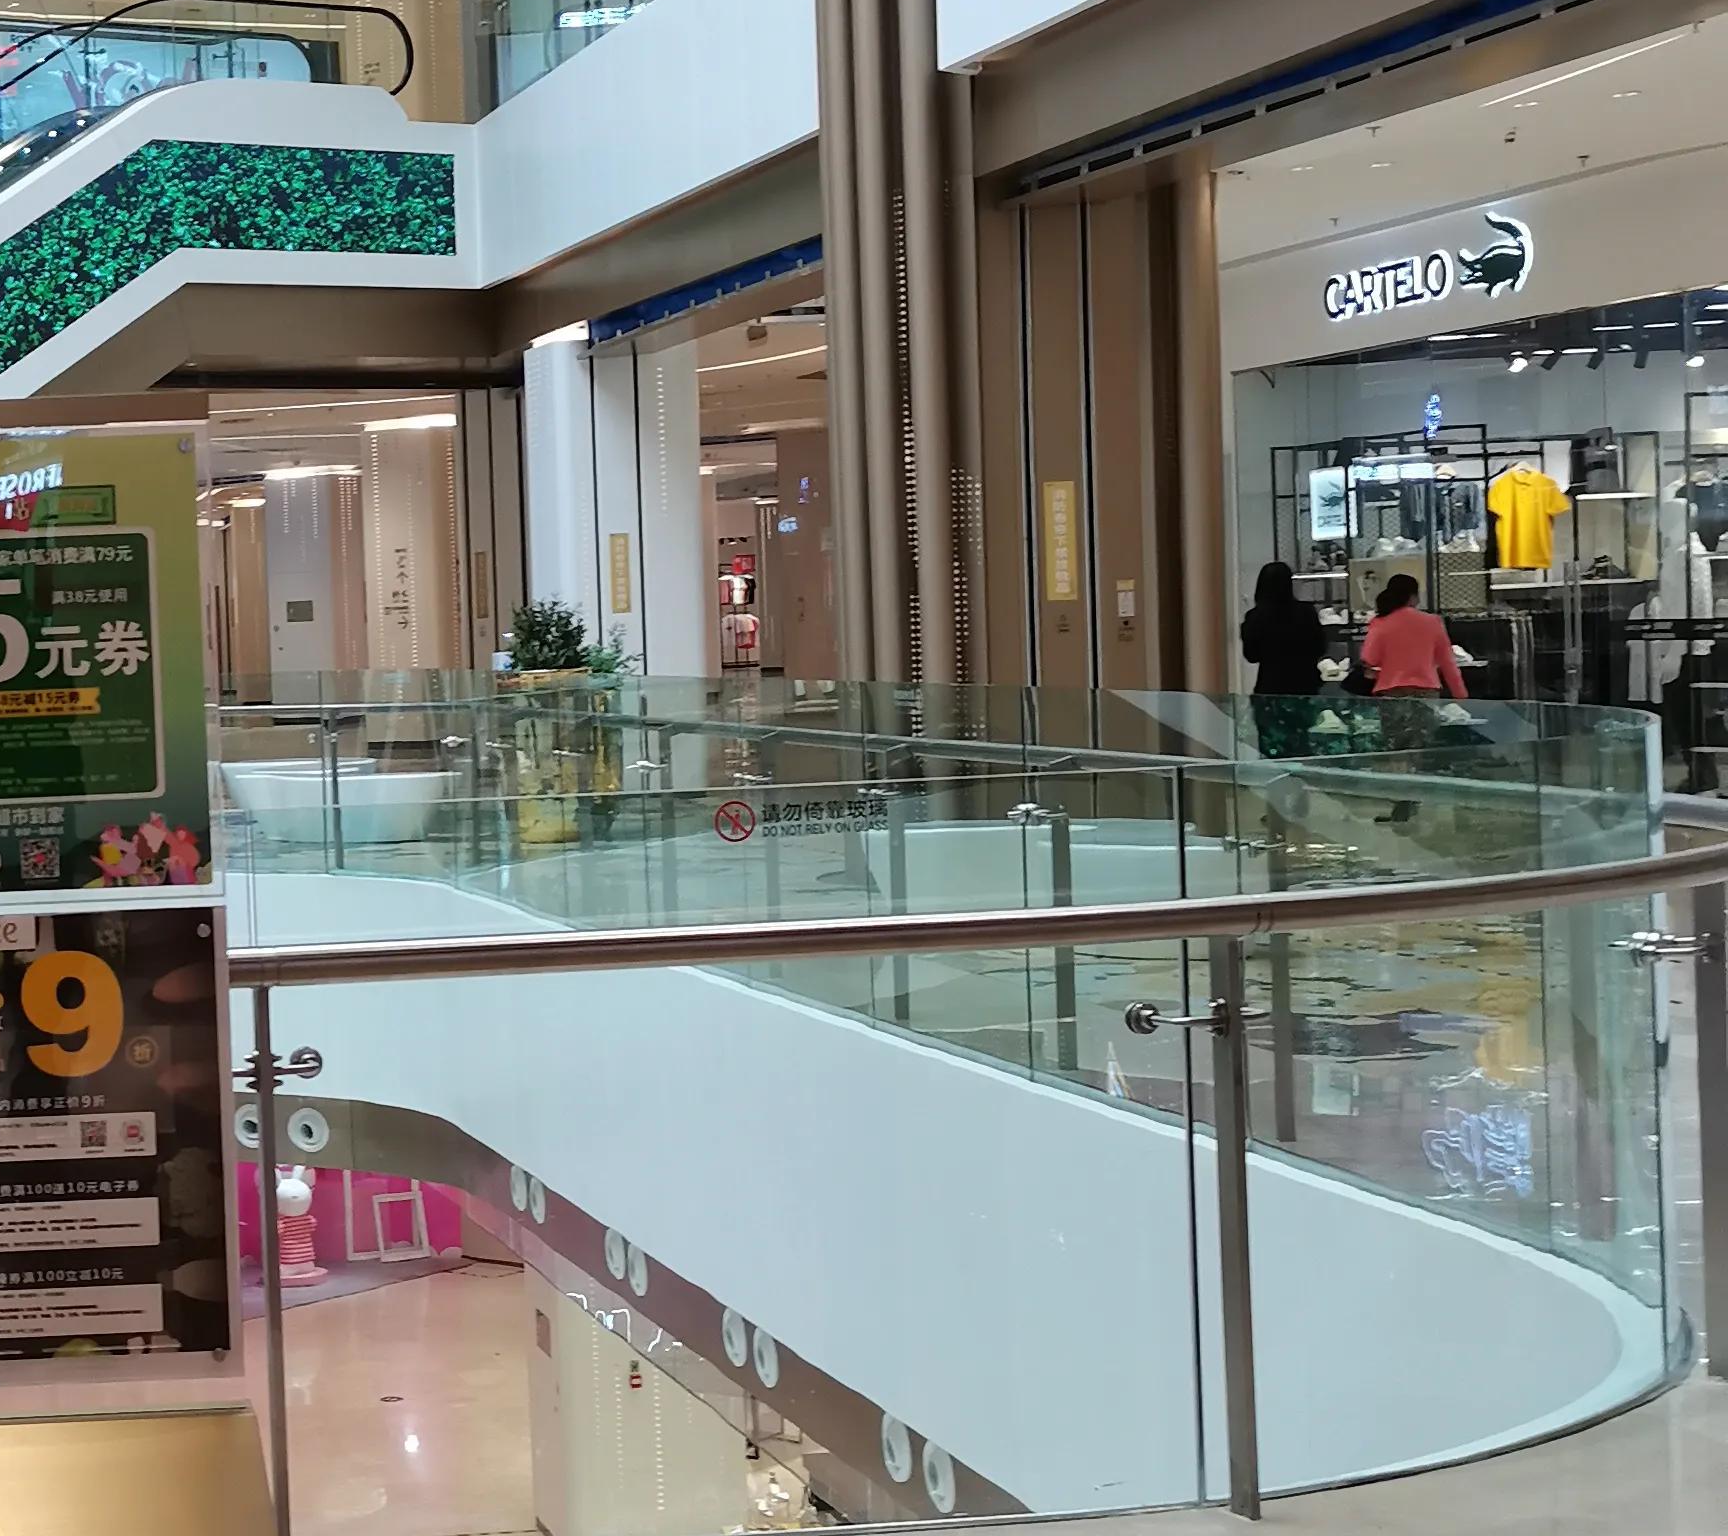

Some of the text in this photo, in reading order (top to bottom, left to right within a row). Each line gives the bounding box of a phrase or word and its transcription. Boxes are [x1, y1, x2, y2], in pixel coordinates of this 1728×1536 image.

[1324, 249, 1455, 322] CARTELO
[762, 799, 889, 822] 请勿倚靠玻璃
[21, 950, 125, 1077] 9
